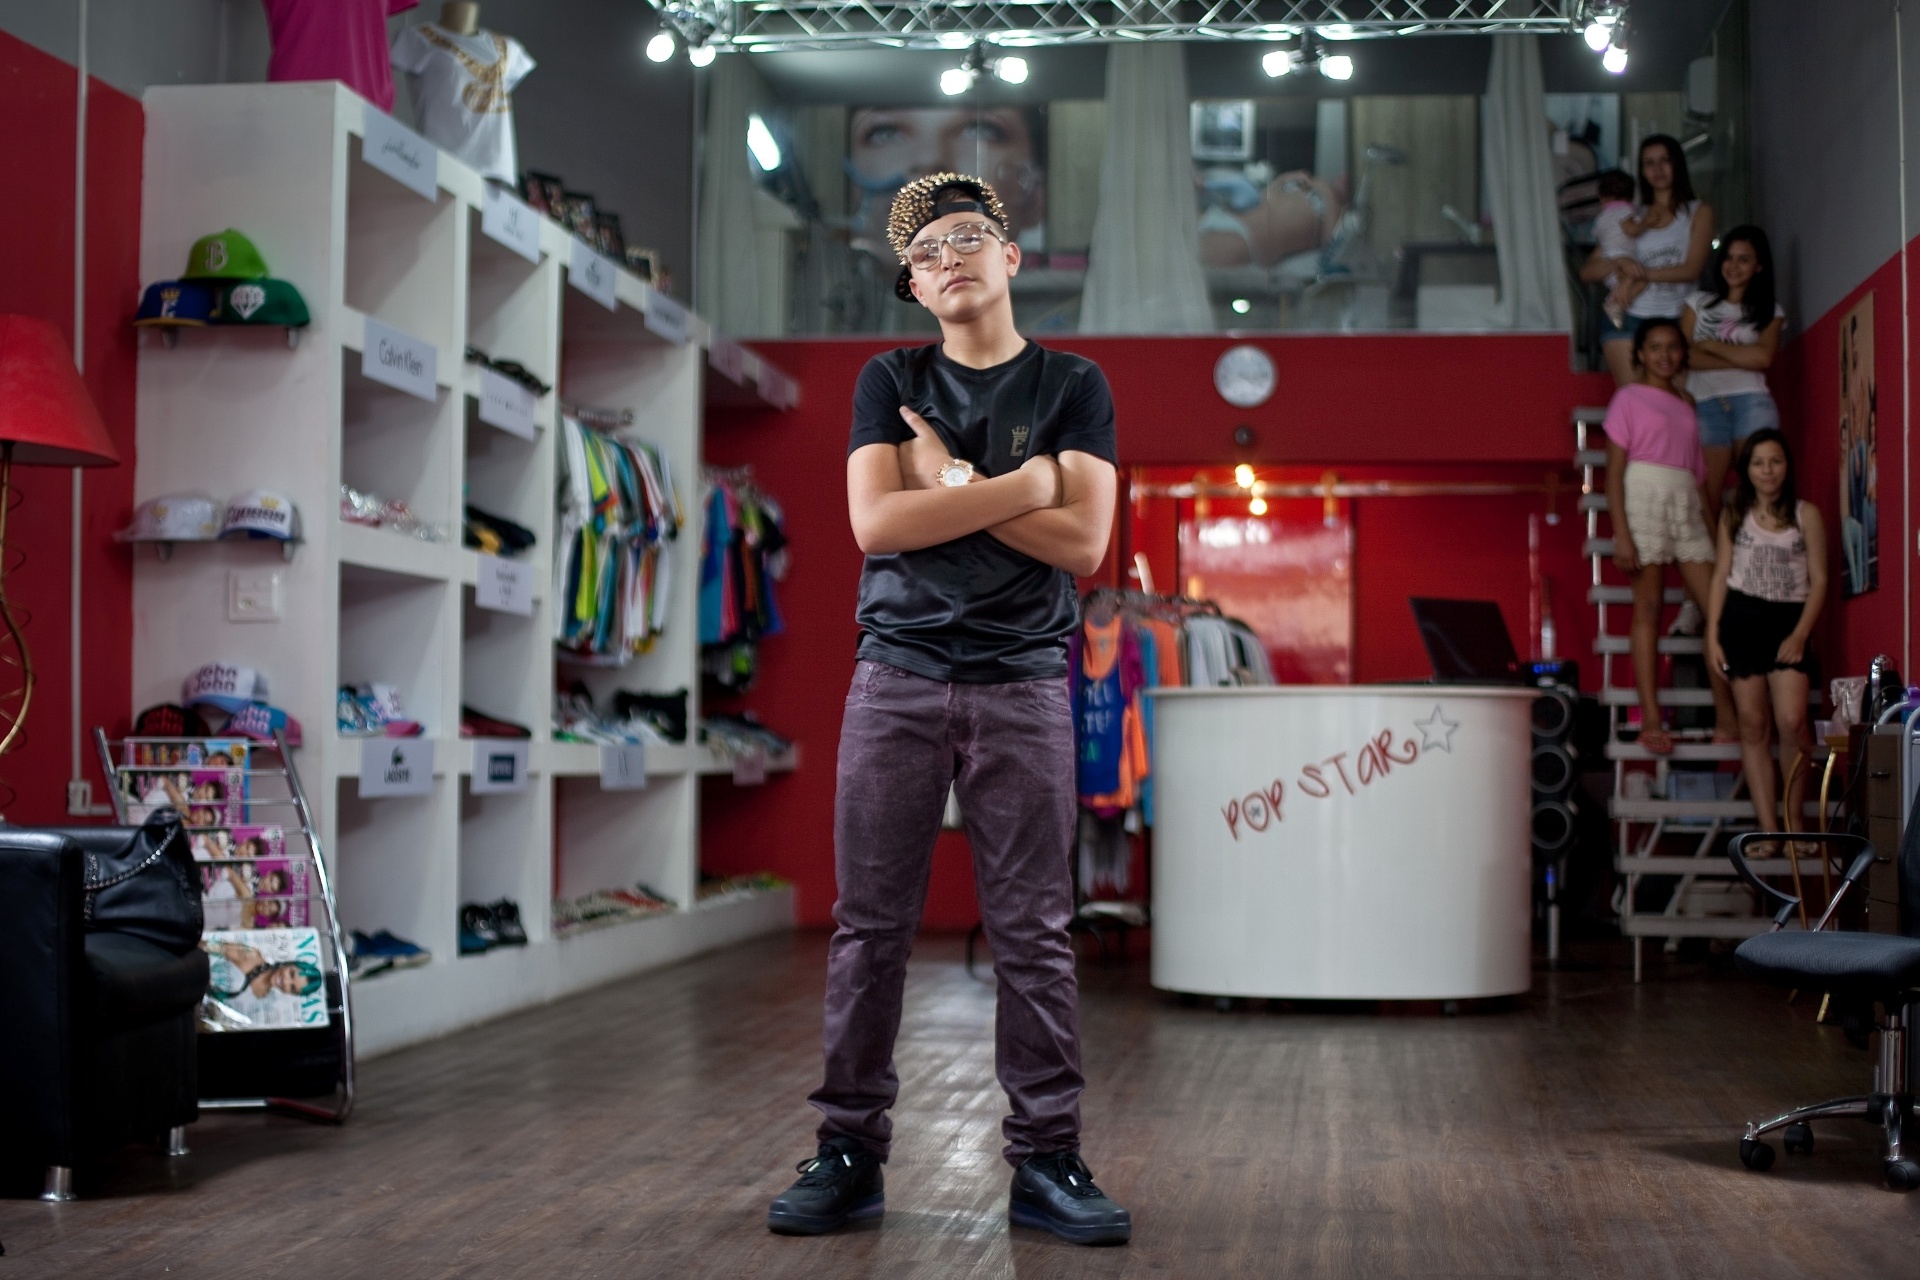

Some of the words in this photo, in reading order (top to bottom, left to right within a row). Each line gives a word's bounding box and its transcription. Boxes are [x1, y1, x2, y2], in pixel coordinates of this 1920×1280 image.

[205, 239, 229, 272] B
[378, 336, 402, 371] Calvin
[402, 349, 423, 377] Klein
[384, 768, 410, 784] LACOSTE
[1220, 779, 1283, 842] POP
[1297, 727, 1418, 799] STAR
[295, 934, 324, 1023] NOAS
